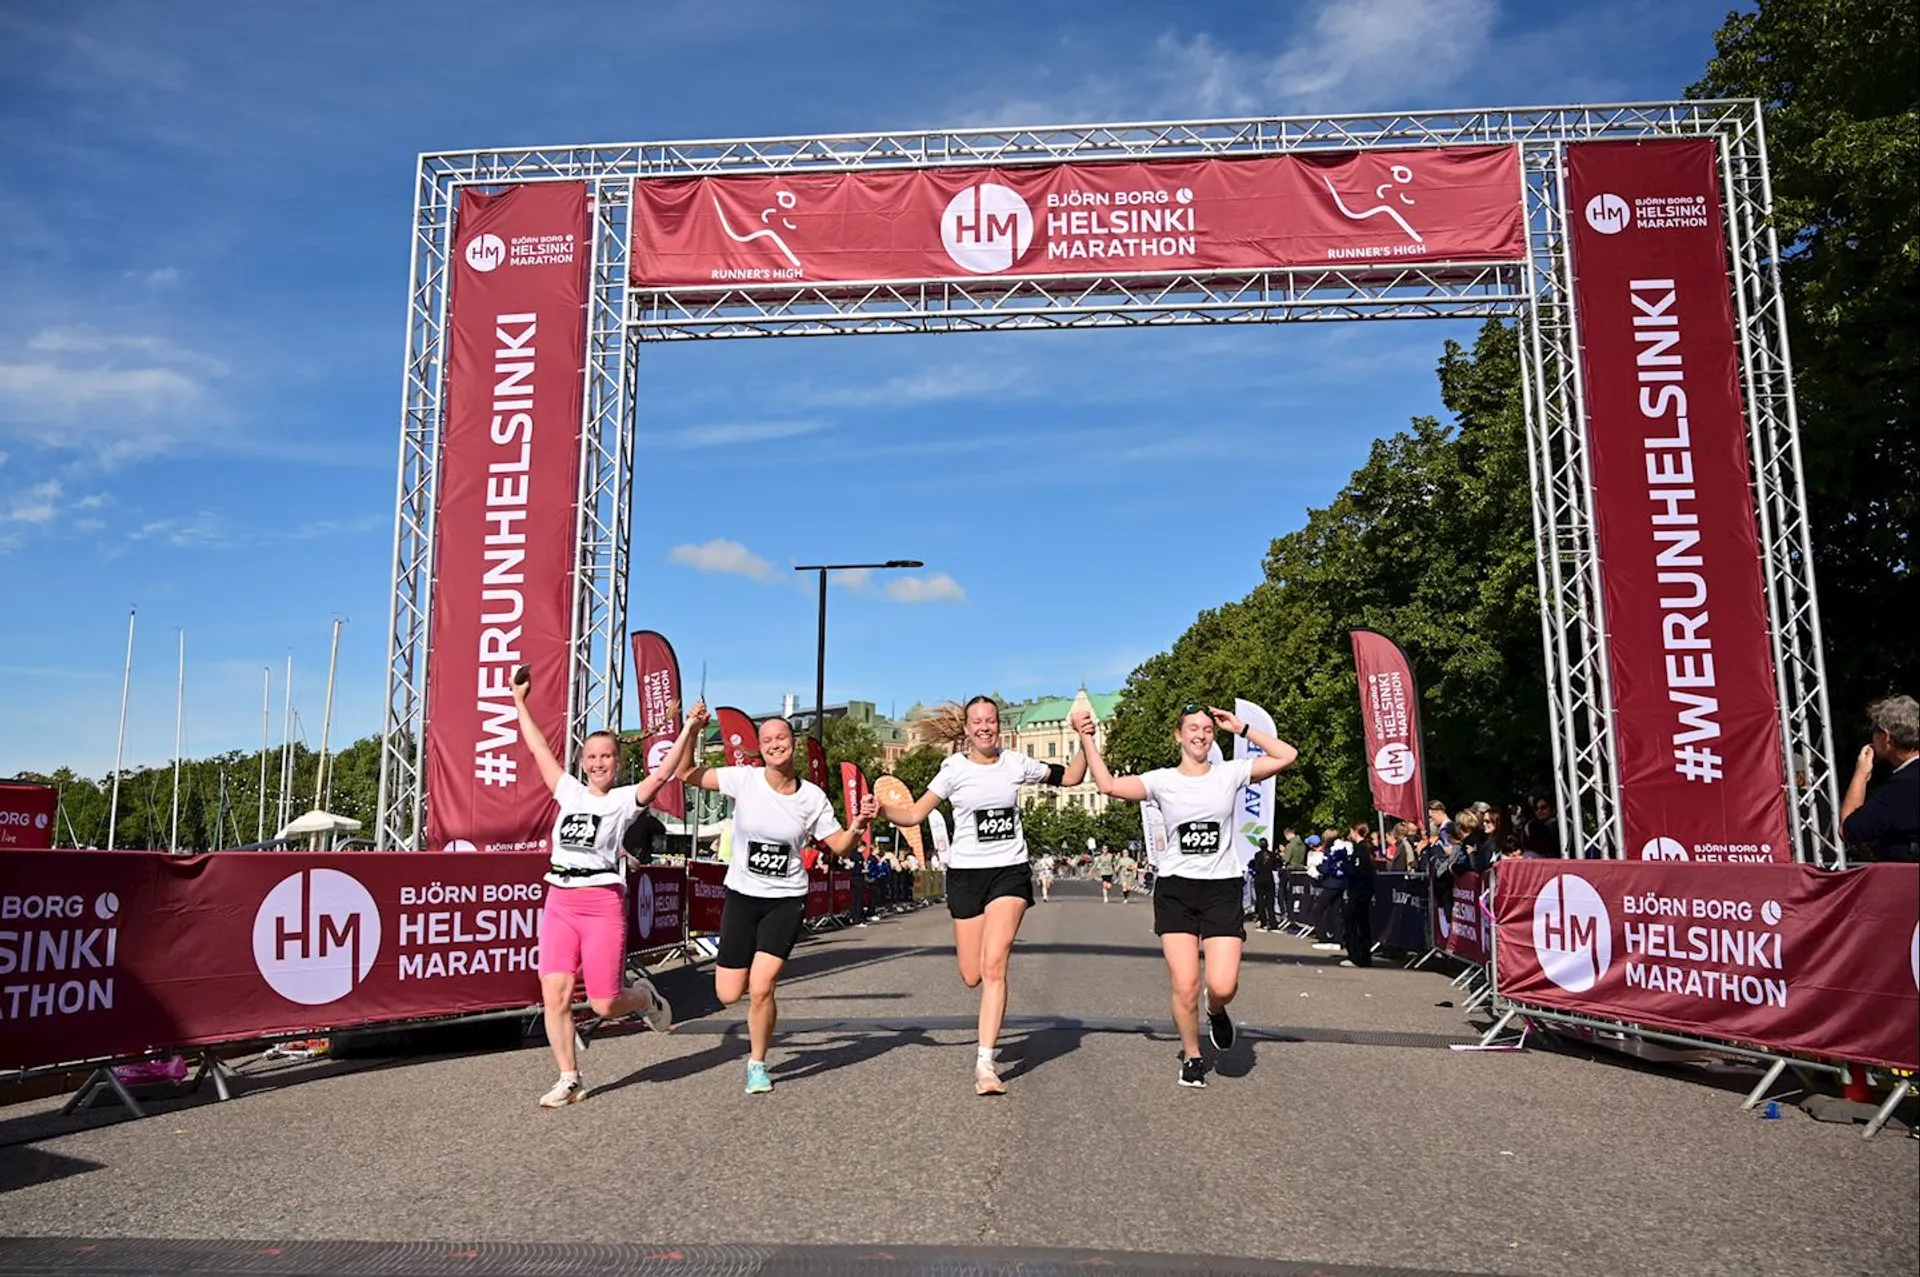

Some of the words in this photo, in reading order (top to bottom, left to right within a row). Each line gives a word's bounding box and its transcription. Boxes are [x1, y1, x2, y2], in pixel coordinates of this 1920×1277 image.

[1047, 190, 1109, 207] BJÖRN
[1115, 191, 1168, 205] BORG
[1635, 198, 1665, 206] BJÖRN
[1636, 205, 1707, 218] HELSINKI
[1048, 208, 1195, 236] HELSINKI
[1637, 217, 1707, 229] MARATHON
[511, 237, 538, 245] BJÖRN
[540, 235, 563, 244] BORG
[511, 243, 573, 256] HELSINKI
[1048, 237, 1196, 259] MARATHON
[511, 254, 572, 266] MARATHON
[1328, 247, 1391, 259] RUNNER'S
[1394, 244, 1427, 256] HIGH
[711, 268, 770, 279] RUNNER'S
[773, 267, 804, 279] HIGH
[1629, 278, 1723, 784] #WERUNHELSINKI
[475, 312, 537, 788] #WERUNHELSINKI
[1378, 673, 1398, 739] HELSINKI
[1391, 671, 1408, 737] MARATHON
[978, 816, 1013, 834] 4926
[1181, 831, 1218, 848] 4925
[1694, 843, 1727, 853] BJÖRN
[1729, 844, 1758, 853] BORG
[750, 851, 788, 870] 4927
[401, 881, 477, 905] BJÖRN
[483, 883, 543, 902] BORG
[1, 895, 84, 919] BORG
[1624, 892, 1687, 916] BJÖRN
[1692, 899, 1752, 921] BORG
[400, 908, 545, 946] HELSIN
[1624, 922, 1783, 970] HELSINKI
[399, 946, 540, 981] MARATHO
[1625, 961, 1787, 1008] MARATHON
